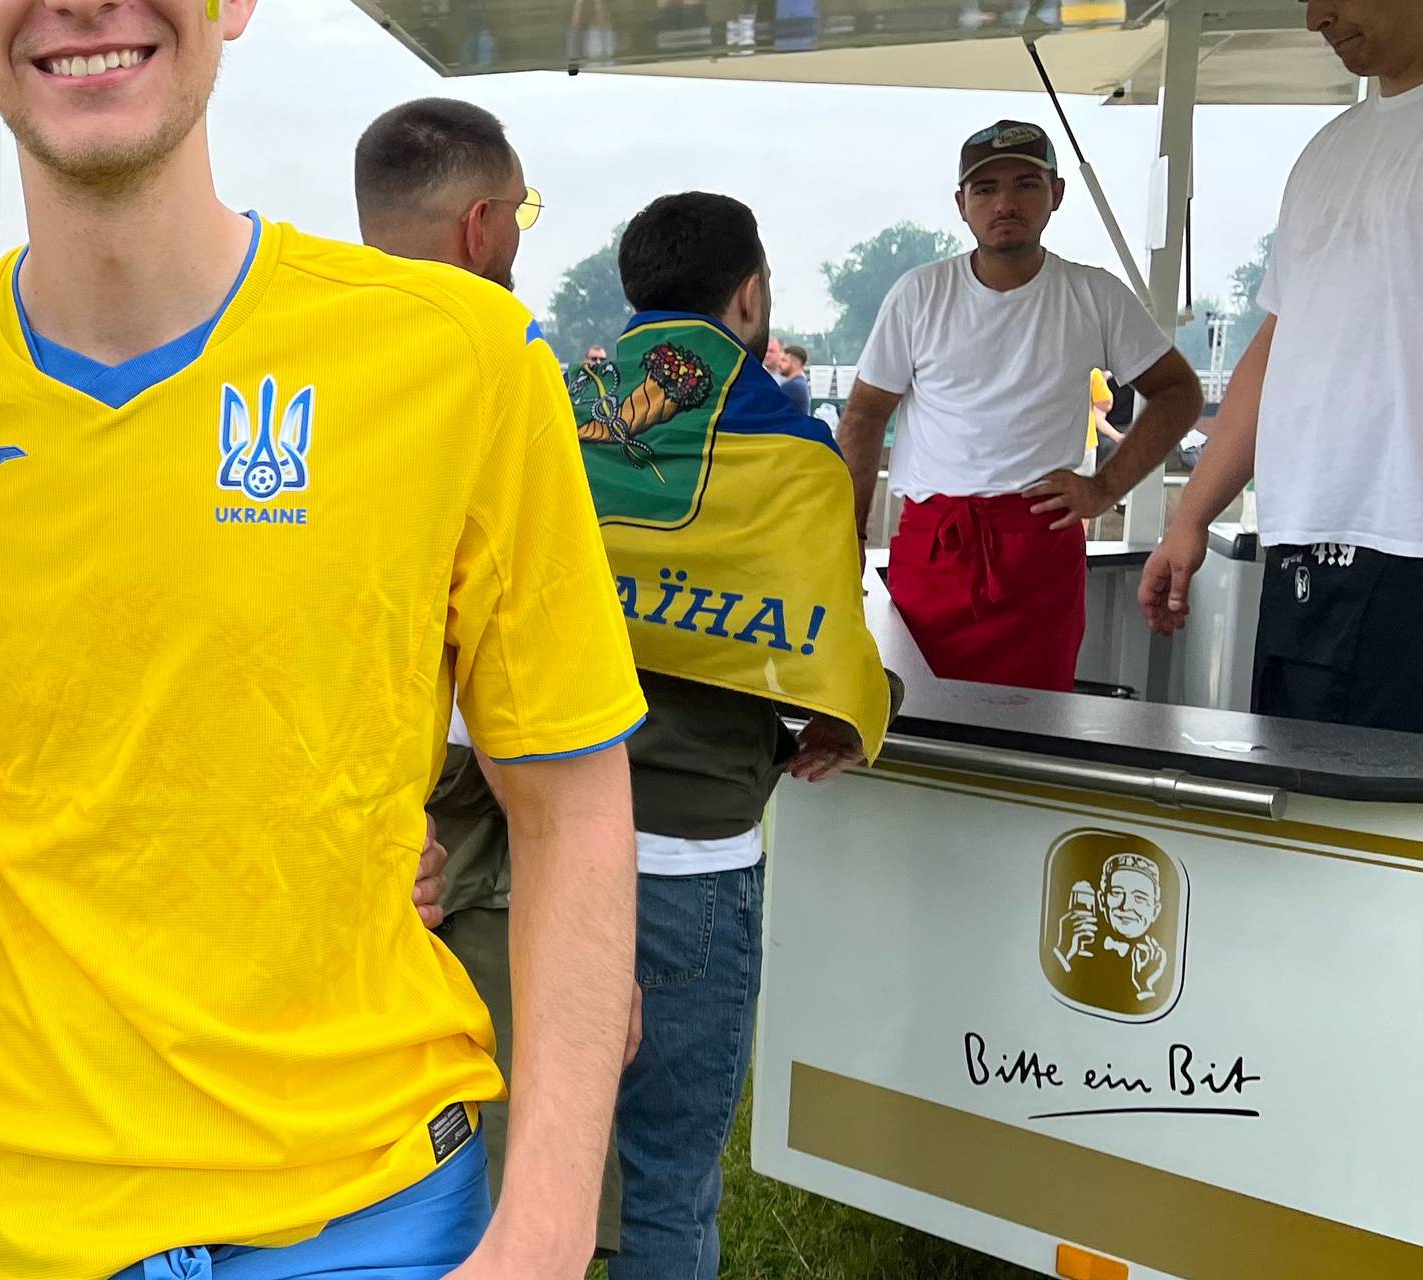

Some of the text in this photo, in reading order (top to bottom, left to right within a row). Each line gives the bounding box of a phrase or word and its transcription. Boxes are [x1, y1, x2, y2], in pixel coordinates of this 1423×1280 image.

[215, 506, 307, 525] UKRAINE
[964, 1032, 1261, 1095] Bitte ein Bit
